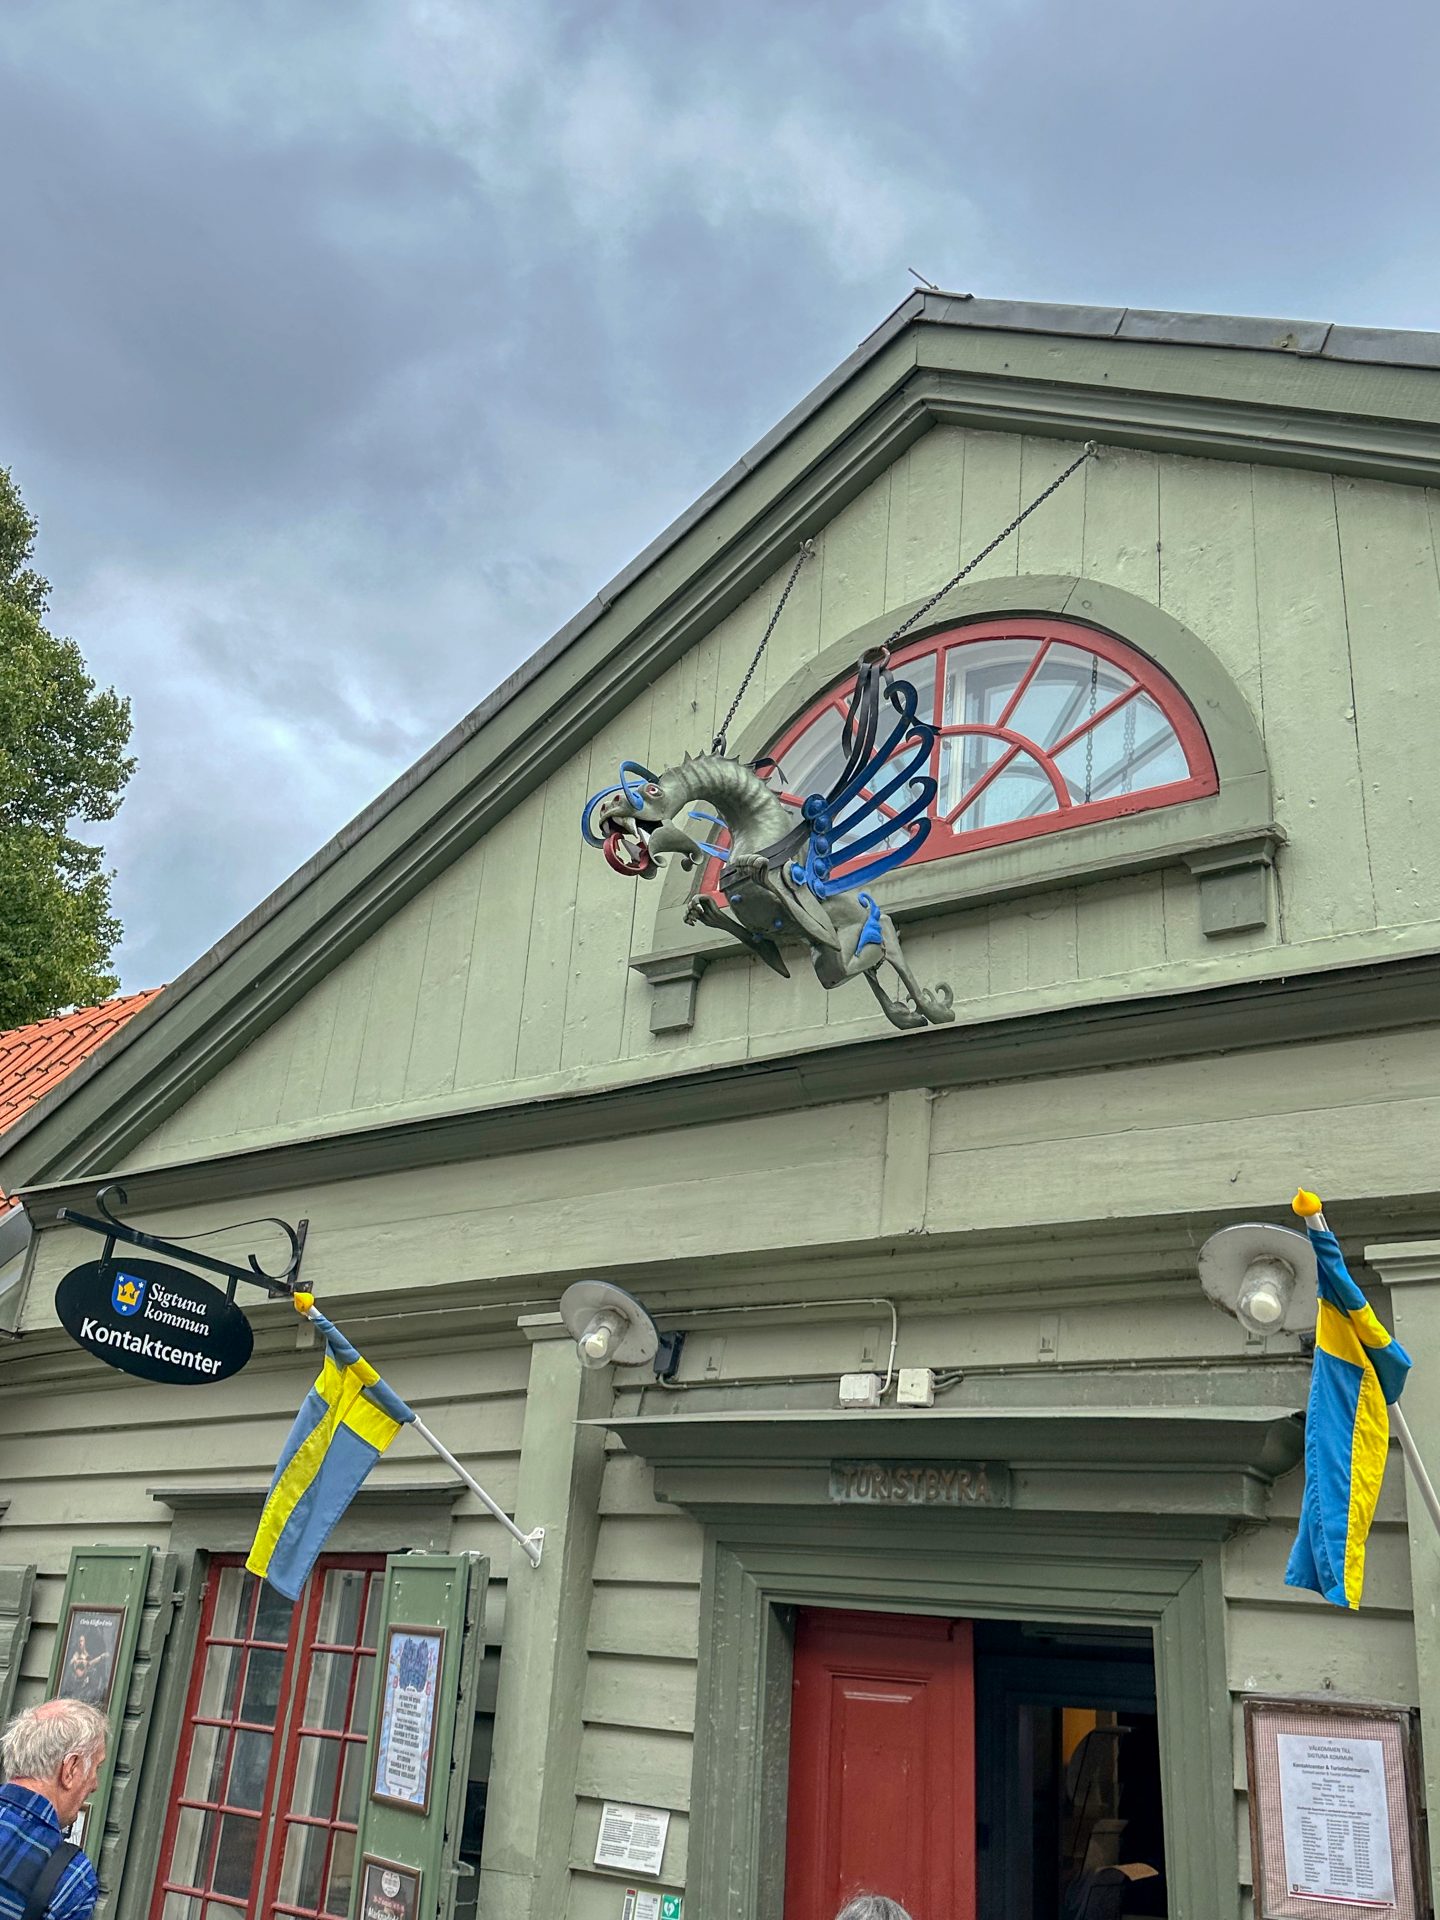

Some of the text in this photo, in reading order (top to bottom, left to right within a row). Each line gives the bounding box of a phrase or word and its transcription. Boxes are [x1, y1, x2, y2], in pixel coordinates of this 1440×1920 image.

[144, 1301, 210, 1336] kommun
[148, 1283, 207, 1316] Sigtuna
[80, 1317, 222, 1375] Kontaktcenter
[842, 1462, 991, 1503] TURISTBYRÅ
